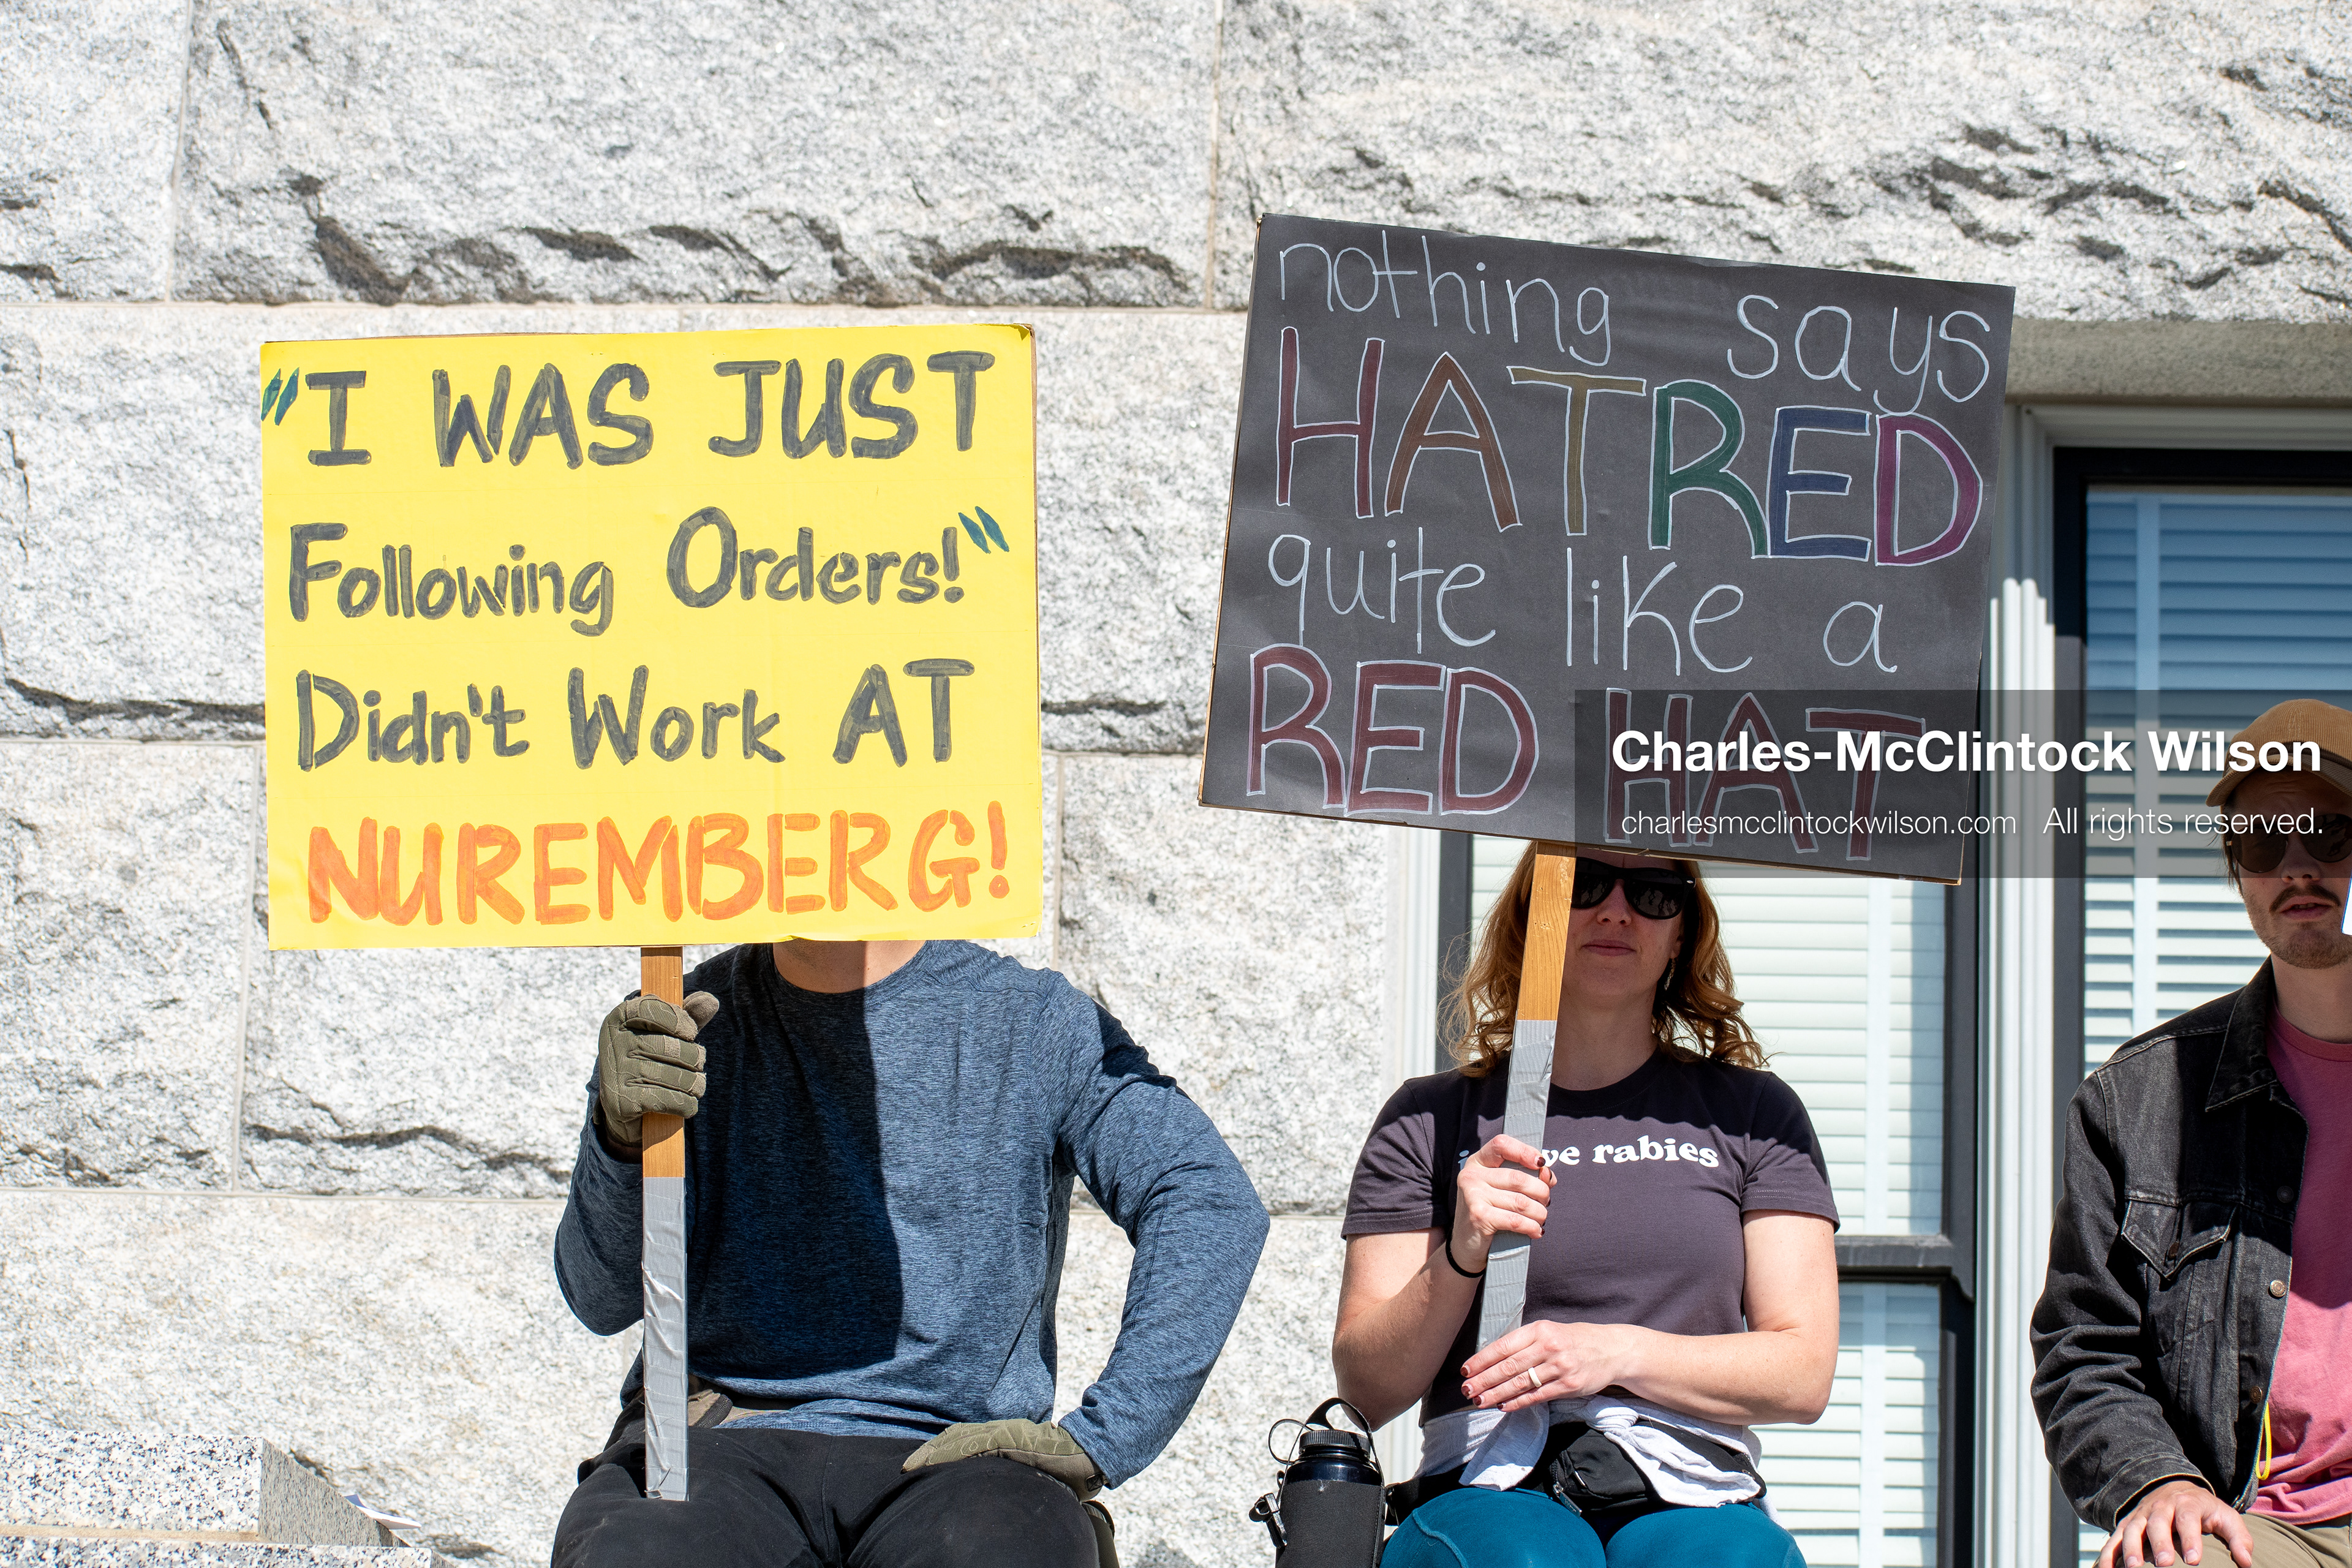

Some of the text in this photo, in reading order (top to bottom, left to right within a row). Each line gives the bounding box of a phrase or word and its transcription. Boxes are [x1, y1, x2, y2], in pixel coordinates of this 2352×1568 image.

[1280, 230, 1991, 414] nothing says
[432, 363, 654, 469] WAS
[708, 351, 995, 459] JUST
[1275, 326, 1983, 566] HATRED
[289, 506, 1009, 636] Following Orders!"
[1267, 526, 1898, 676] quite like a
[296, 658, 975, 771] Didn't Work AT
[1246, 643, 1926, 861] RED HAT
[308, 801, 1009, 925] NUREMBERG!
[1592, 1135, 1719, 1167] rabies
